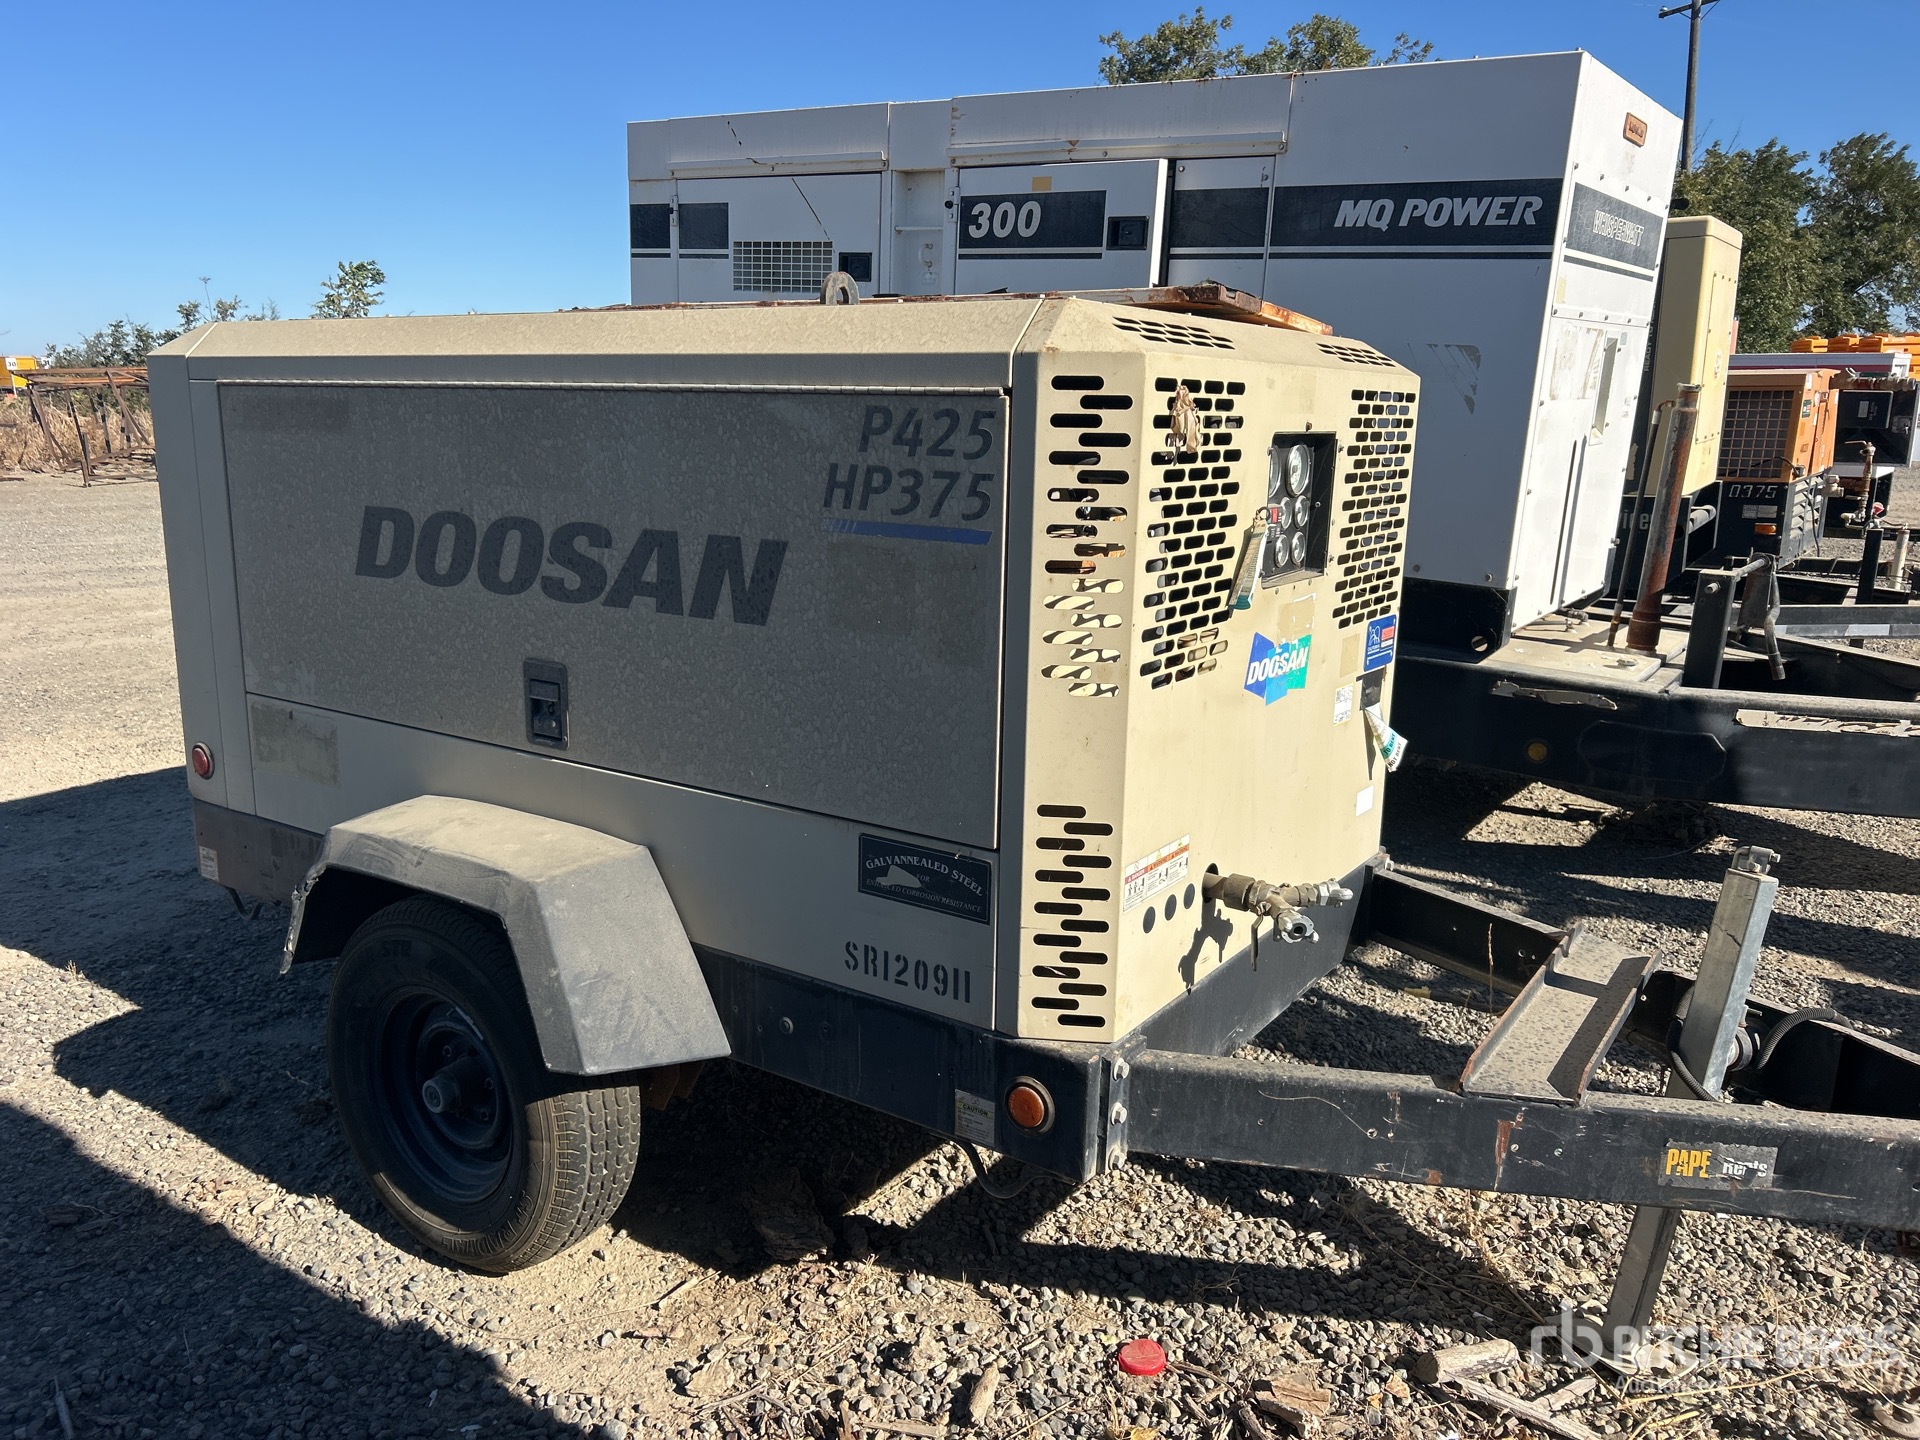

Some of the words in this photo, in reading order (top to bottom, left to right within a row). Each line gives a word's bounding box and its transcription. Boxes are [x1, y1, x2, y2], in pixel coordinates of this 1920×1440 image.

[968, 200, 1042, 239] 300
[1333, 198, 1395, 232] MQ
[1398, 195, 1544, 228] POWER
[858, 404, 997, 460] P425
[823, 462, 996, 522] HP375
[1728, 484, 1778, 499] 0375
[354, 504, 789, 627] DOOSAN
[1246, 645, 1309, 686] DOOSAN
[865, 855, 949, 874] GALVANNEALED
[951, 869, 983, 897] STEEL
[915, 873, 930, 883] FOR
[901, 887, 940, 902] CORROSION
[940, 897, 982, 912] RESISTANCE
[962, 1104, 989, 1117] CAUTION
[441, 1220, 518, 1257] RADIAL
